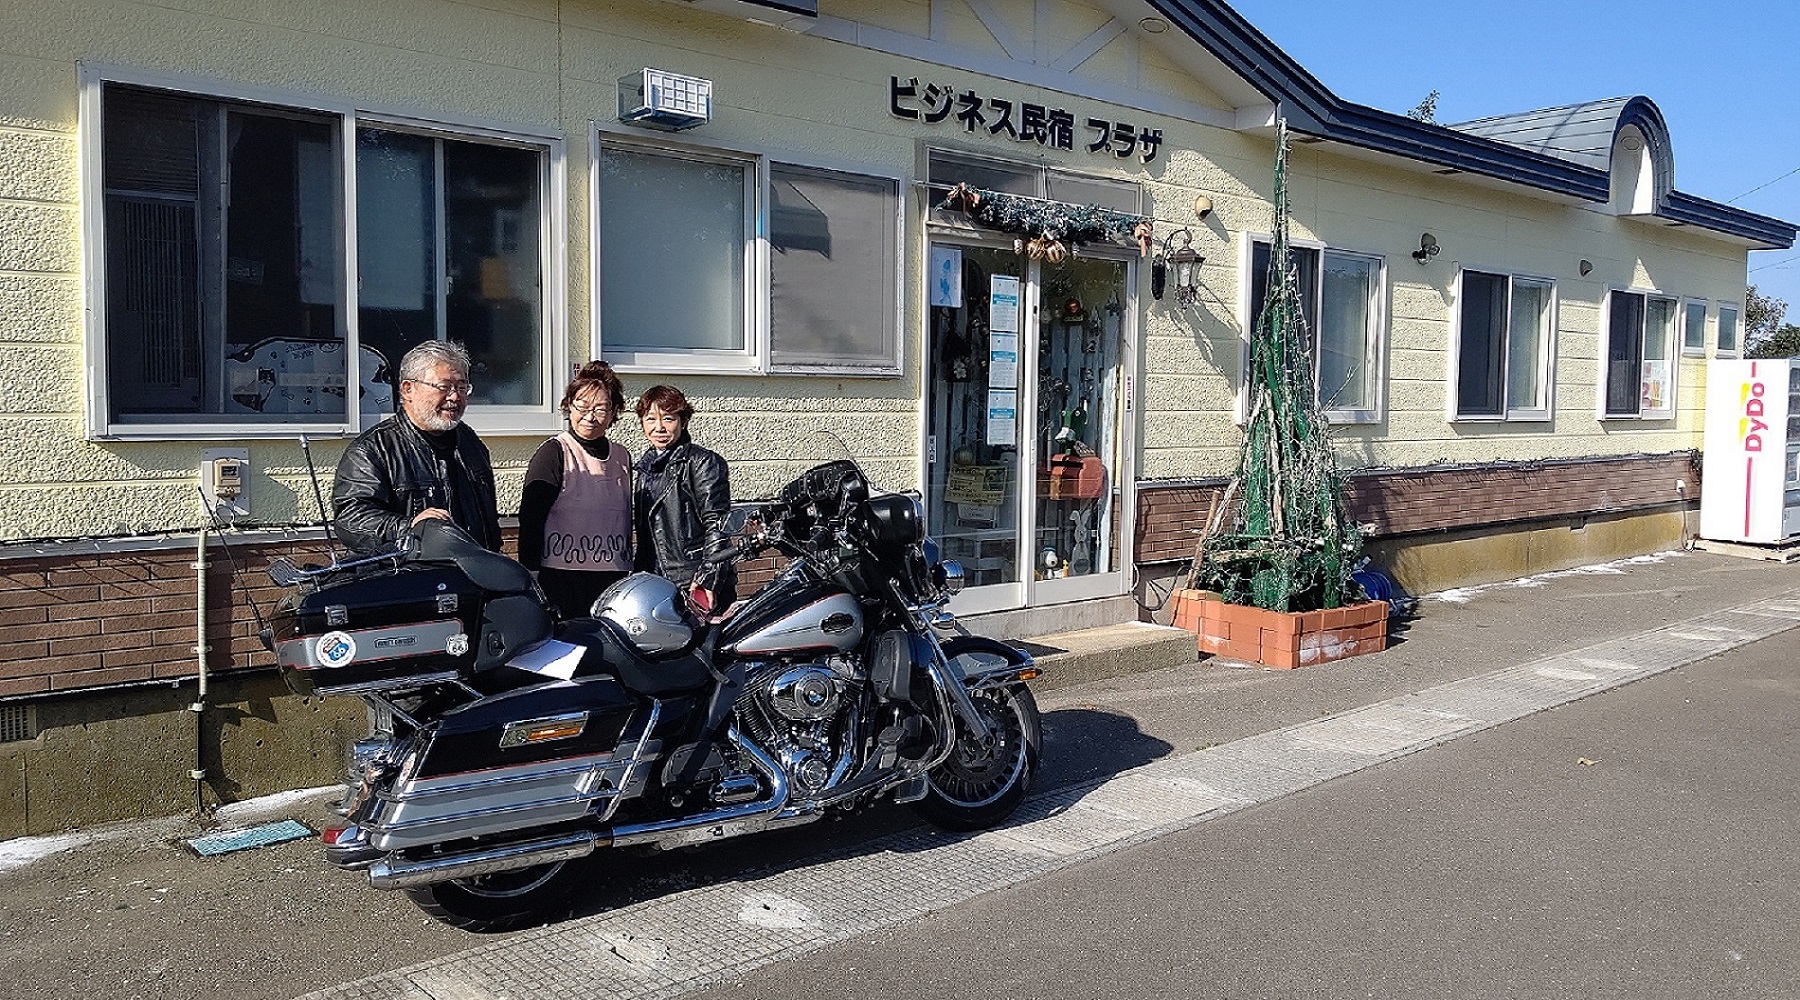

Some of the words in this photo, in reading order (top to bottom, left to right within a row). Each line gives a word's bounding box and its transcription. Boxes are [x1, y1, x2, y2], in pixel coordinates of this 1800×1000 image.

[891, 75, 1074, 150] ビジネス民宿
[1086, 117, 1163, 164] プラザ
[1745, 382, 1768, 452] DyDo
